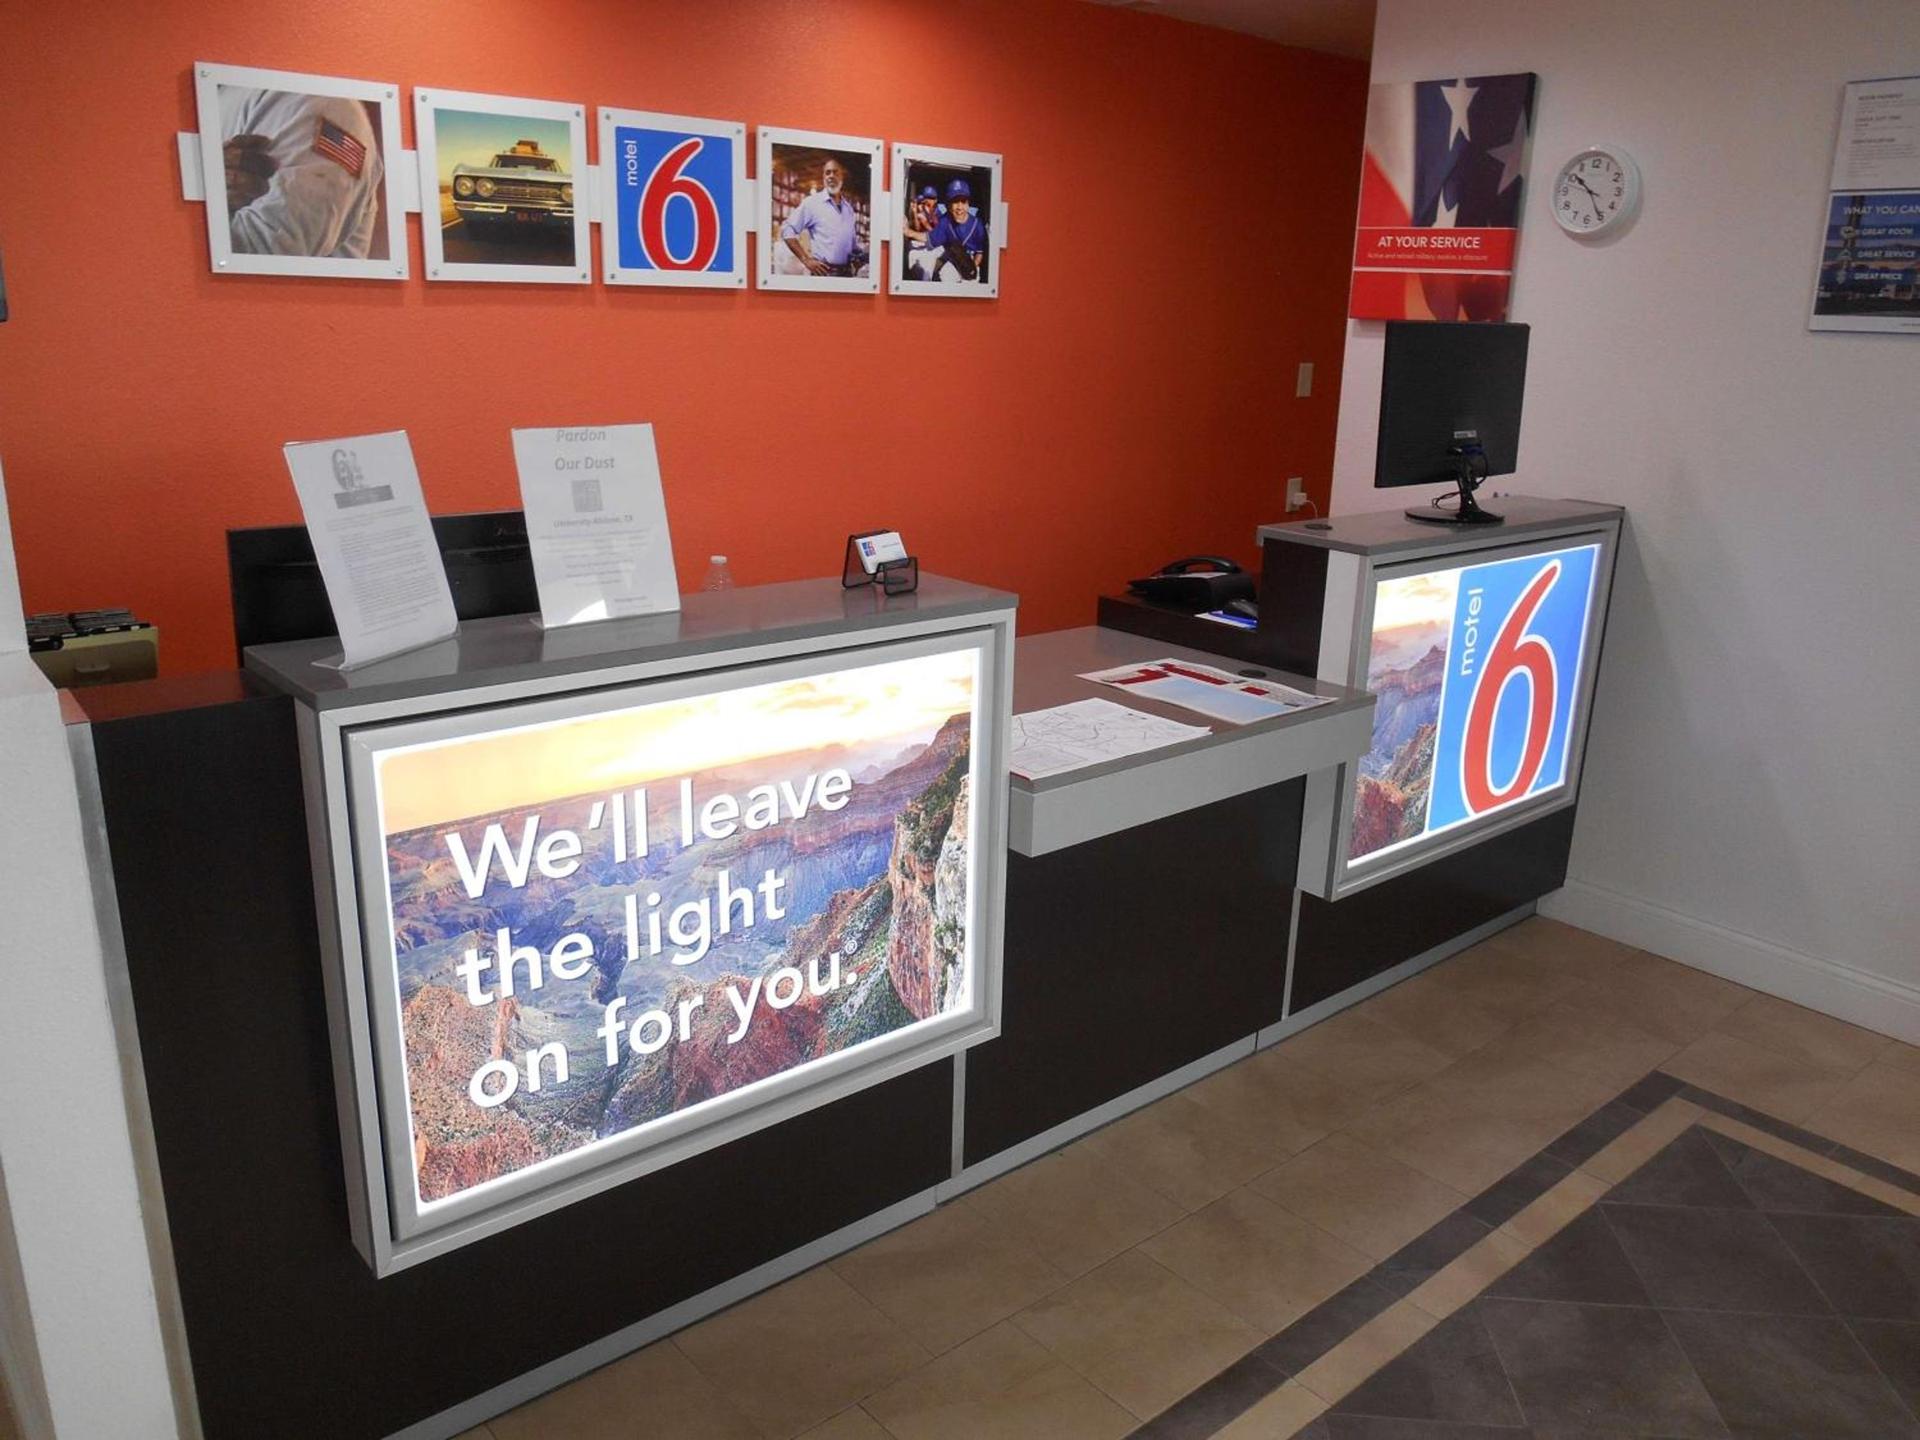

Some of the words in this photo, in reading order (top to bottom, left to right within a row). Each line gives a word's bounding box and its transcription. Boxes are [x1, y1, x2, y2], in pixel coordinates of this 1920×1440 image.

[1592, 158, 1602, 169] 12
[1605, 161, 1610, 172] 1
[1612, 172, 1623, 183] 2
[1561, 186, 1569, 197] 9
[1614, 186, 1622, 197] 3
[623, 139, 638, 187] motel
[638, 137, 720, 273] 6
[1563, 200, 1571, 210] 8
[1608, 201, 1615, 210] 4
[1843, 206, 1872, 215] WHAT
[1875, 205, 1897, 215] YOU
[1573, 210, 1579, 220] 7
[1583, 214, 1591, 225] 6
[1597, 210, 1605, 221] 5
[1861, 228, 1886, 236] GREAT
[1378, 236, 1394, 248] AT
[1396, 236, 1428, 248] YOUR
[1430, 236, 1481, 249] SERVICE
[555, 427, 606, 442] Pardon
[554, 456, 581, 471] Our
[584, 456, 615, 470] Dust
[1461, 587, 1484, 676] motel
[1459, 558, 1562, 818] 6
[444, 788, 650, 899] We'll
[680, 766, 854, 848] leave
[457, 927, 595, 1007] the
[624, 867, 786, 966] light
[468, 1041, 569, 1109] on
[597, 994, 704, 1067] for
